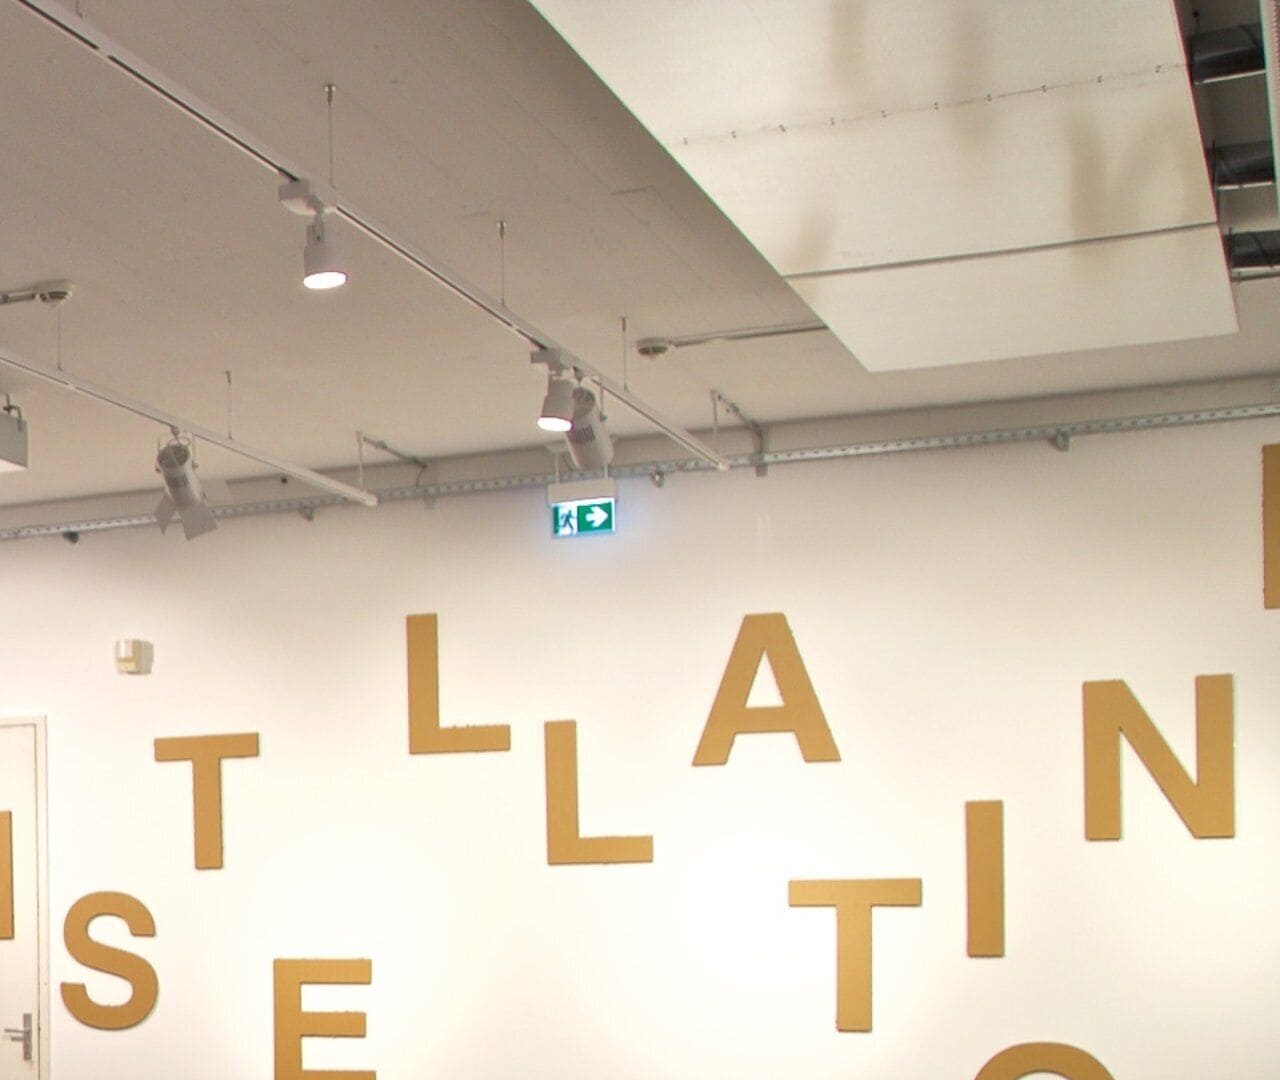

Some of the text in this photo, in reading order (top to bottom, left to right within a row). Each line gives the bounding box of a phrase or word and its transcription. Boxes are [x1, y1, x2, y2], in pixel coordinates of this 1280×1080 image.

[59, 889, 158, 1030] S
[155, 731, 260, 870] T
[405, 613, 512, 754] L
[544, 719, 653, 866] L
[692, 611, 841, 767] A
[787, 878, 922, 1033] T
[966, 799, 1004, 958] I
[1082, 673, 1235, 840] N
